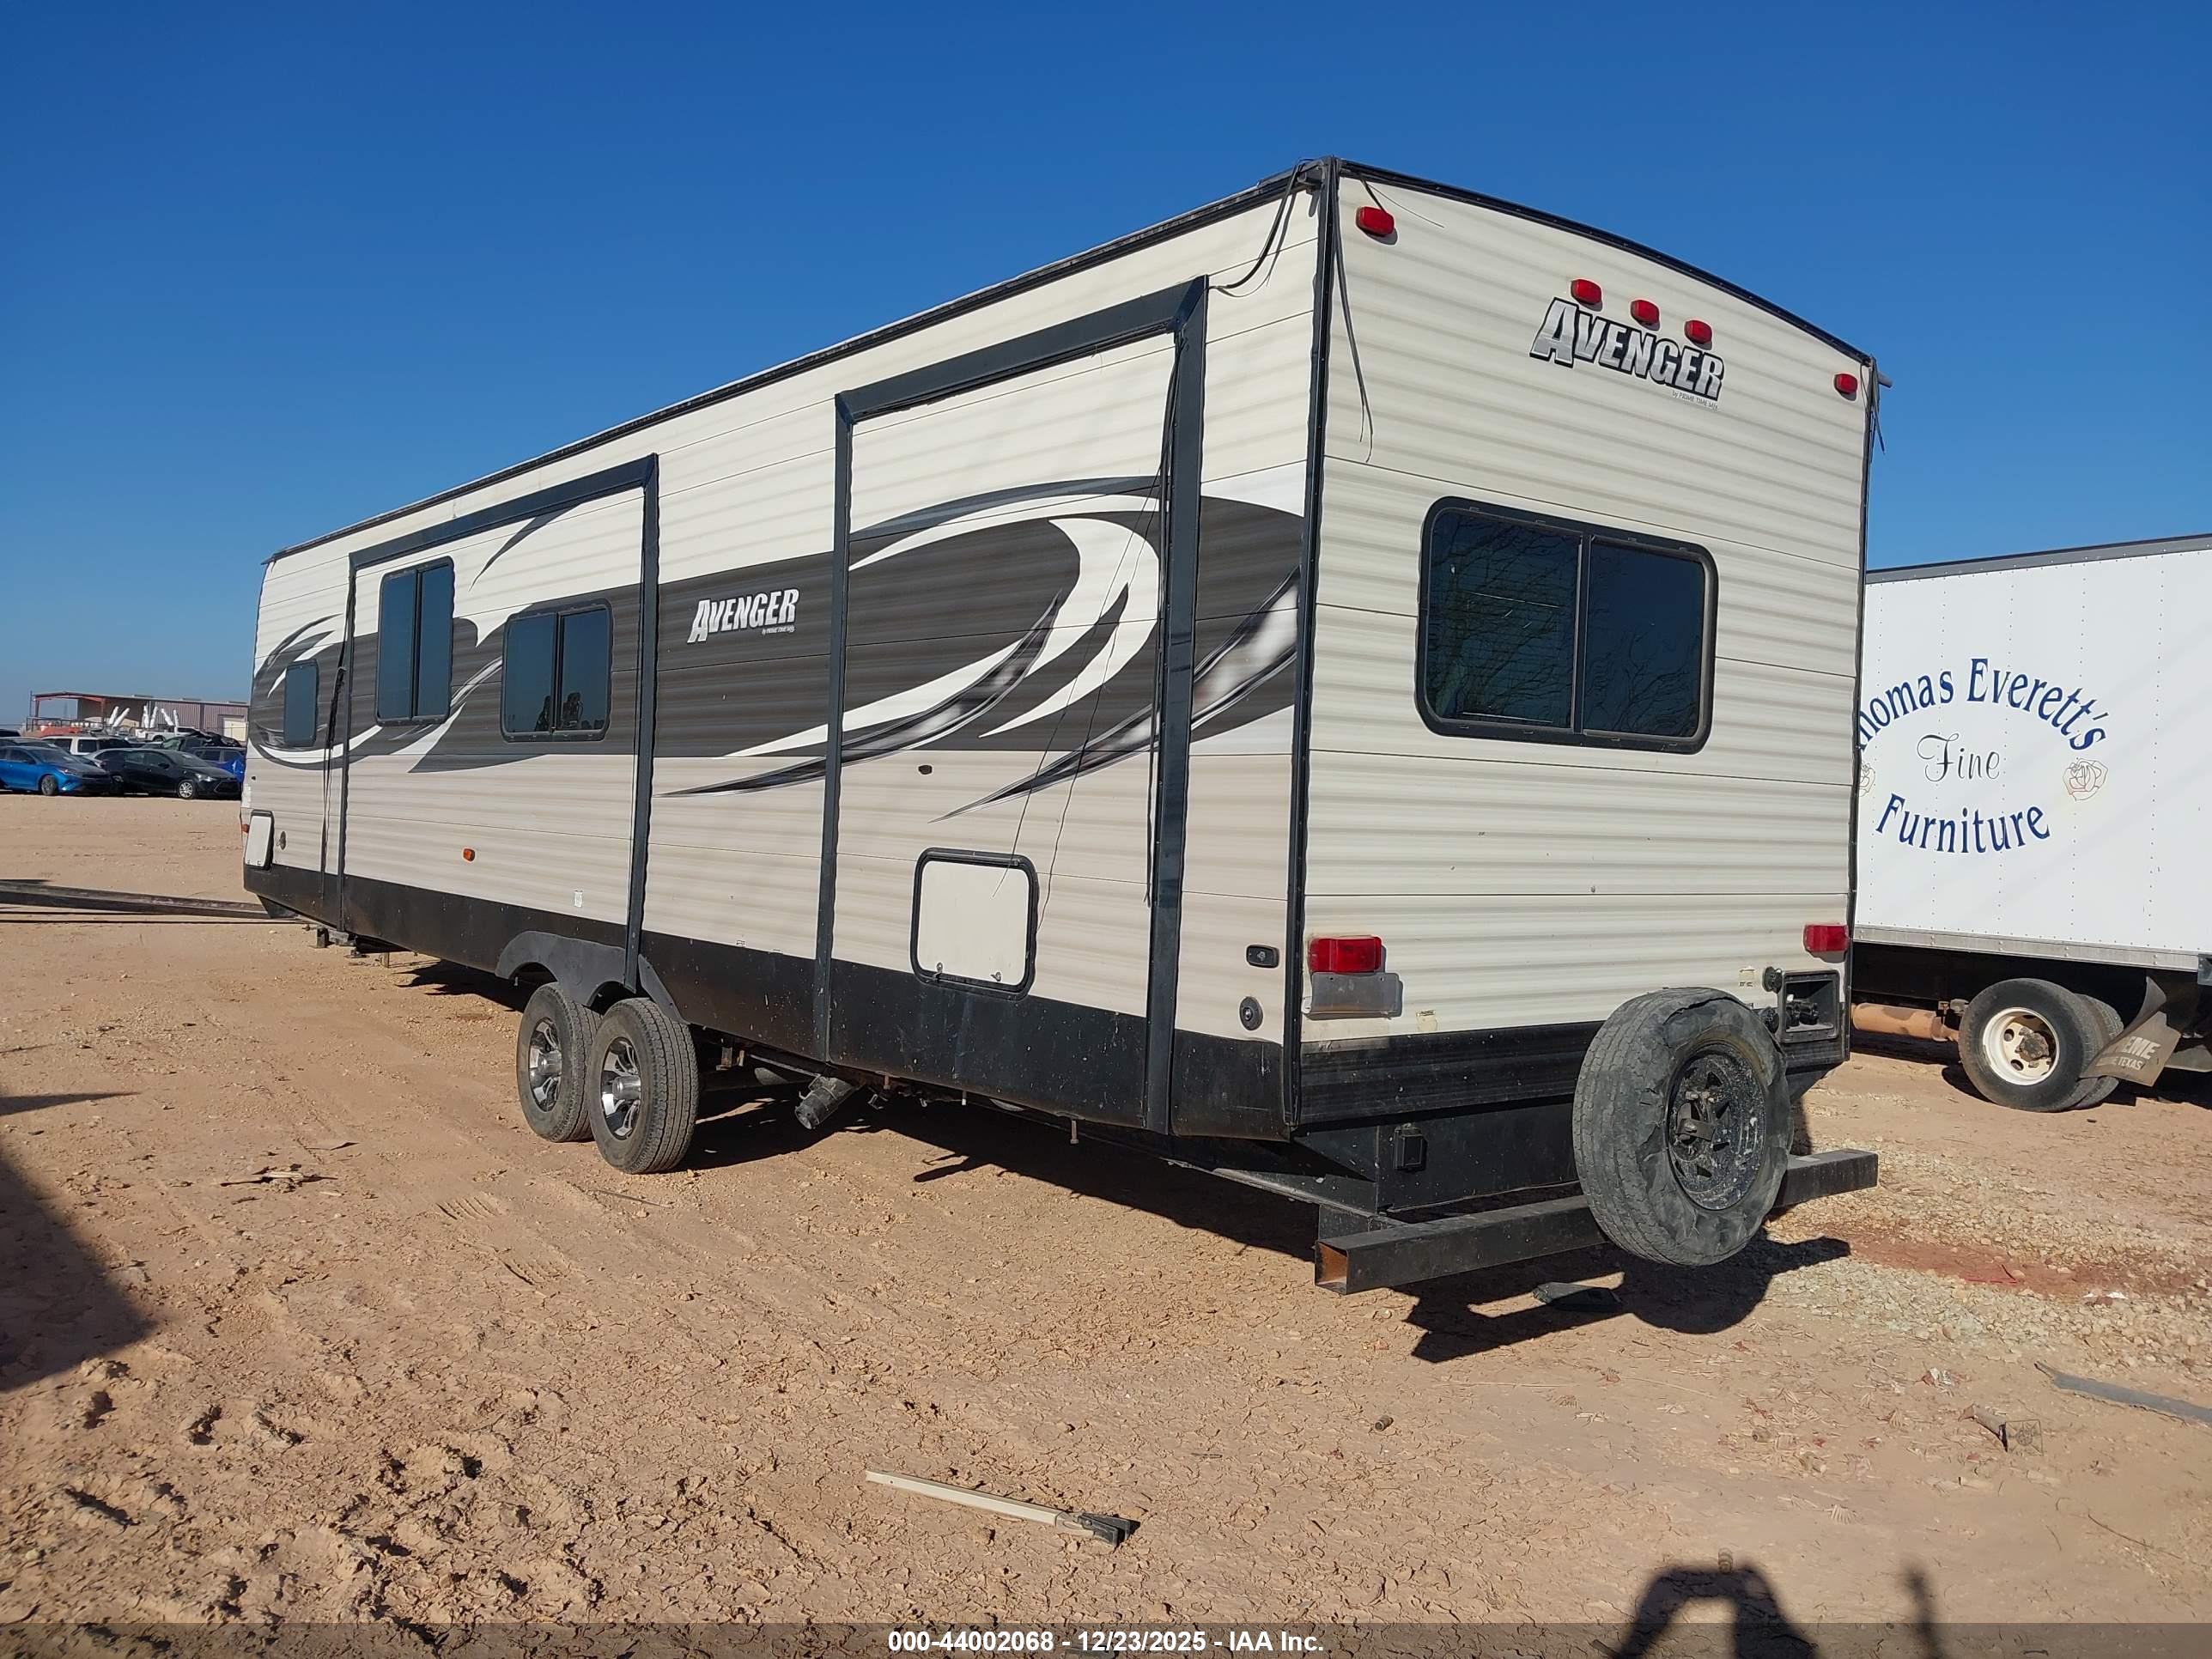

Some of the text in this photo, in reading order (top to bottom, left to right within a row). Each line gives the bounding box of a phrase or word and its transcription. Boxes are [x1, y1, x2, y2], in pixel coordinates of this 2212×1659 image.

[1529, 297, 1724, 401] AVENGER
[687, 588, 799, 644] AVENGER
[1859, 658, 2109, 752] homas Everett's
[1917, 732, 2001, 782] Fine
[1875, 793, 2051, 854] Furniture
[2118, 1056, 2144, 1071] TEXAS
